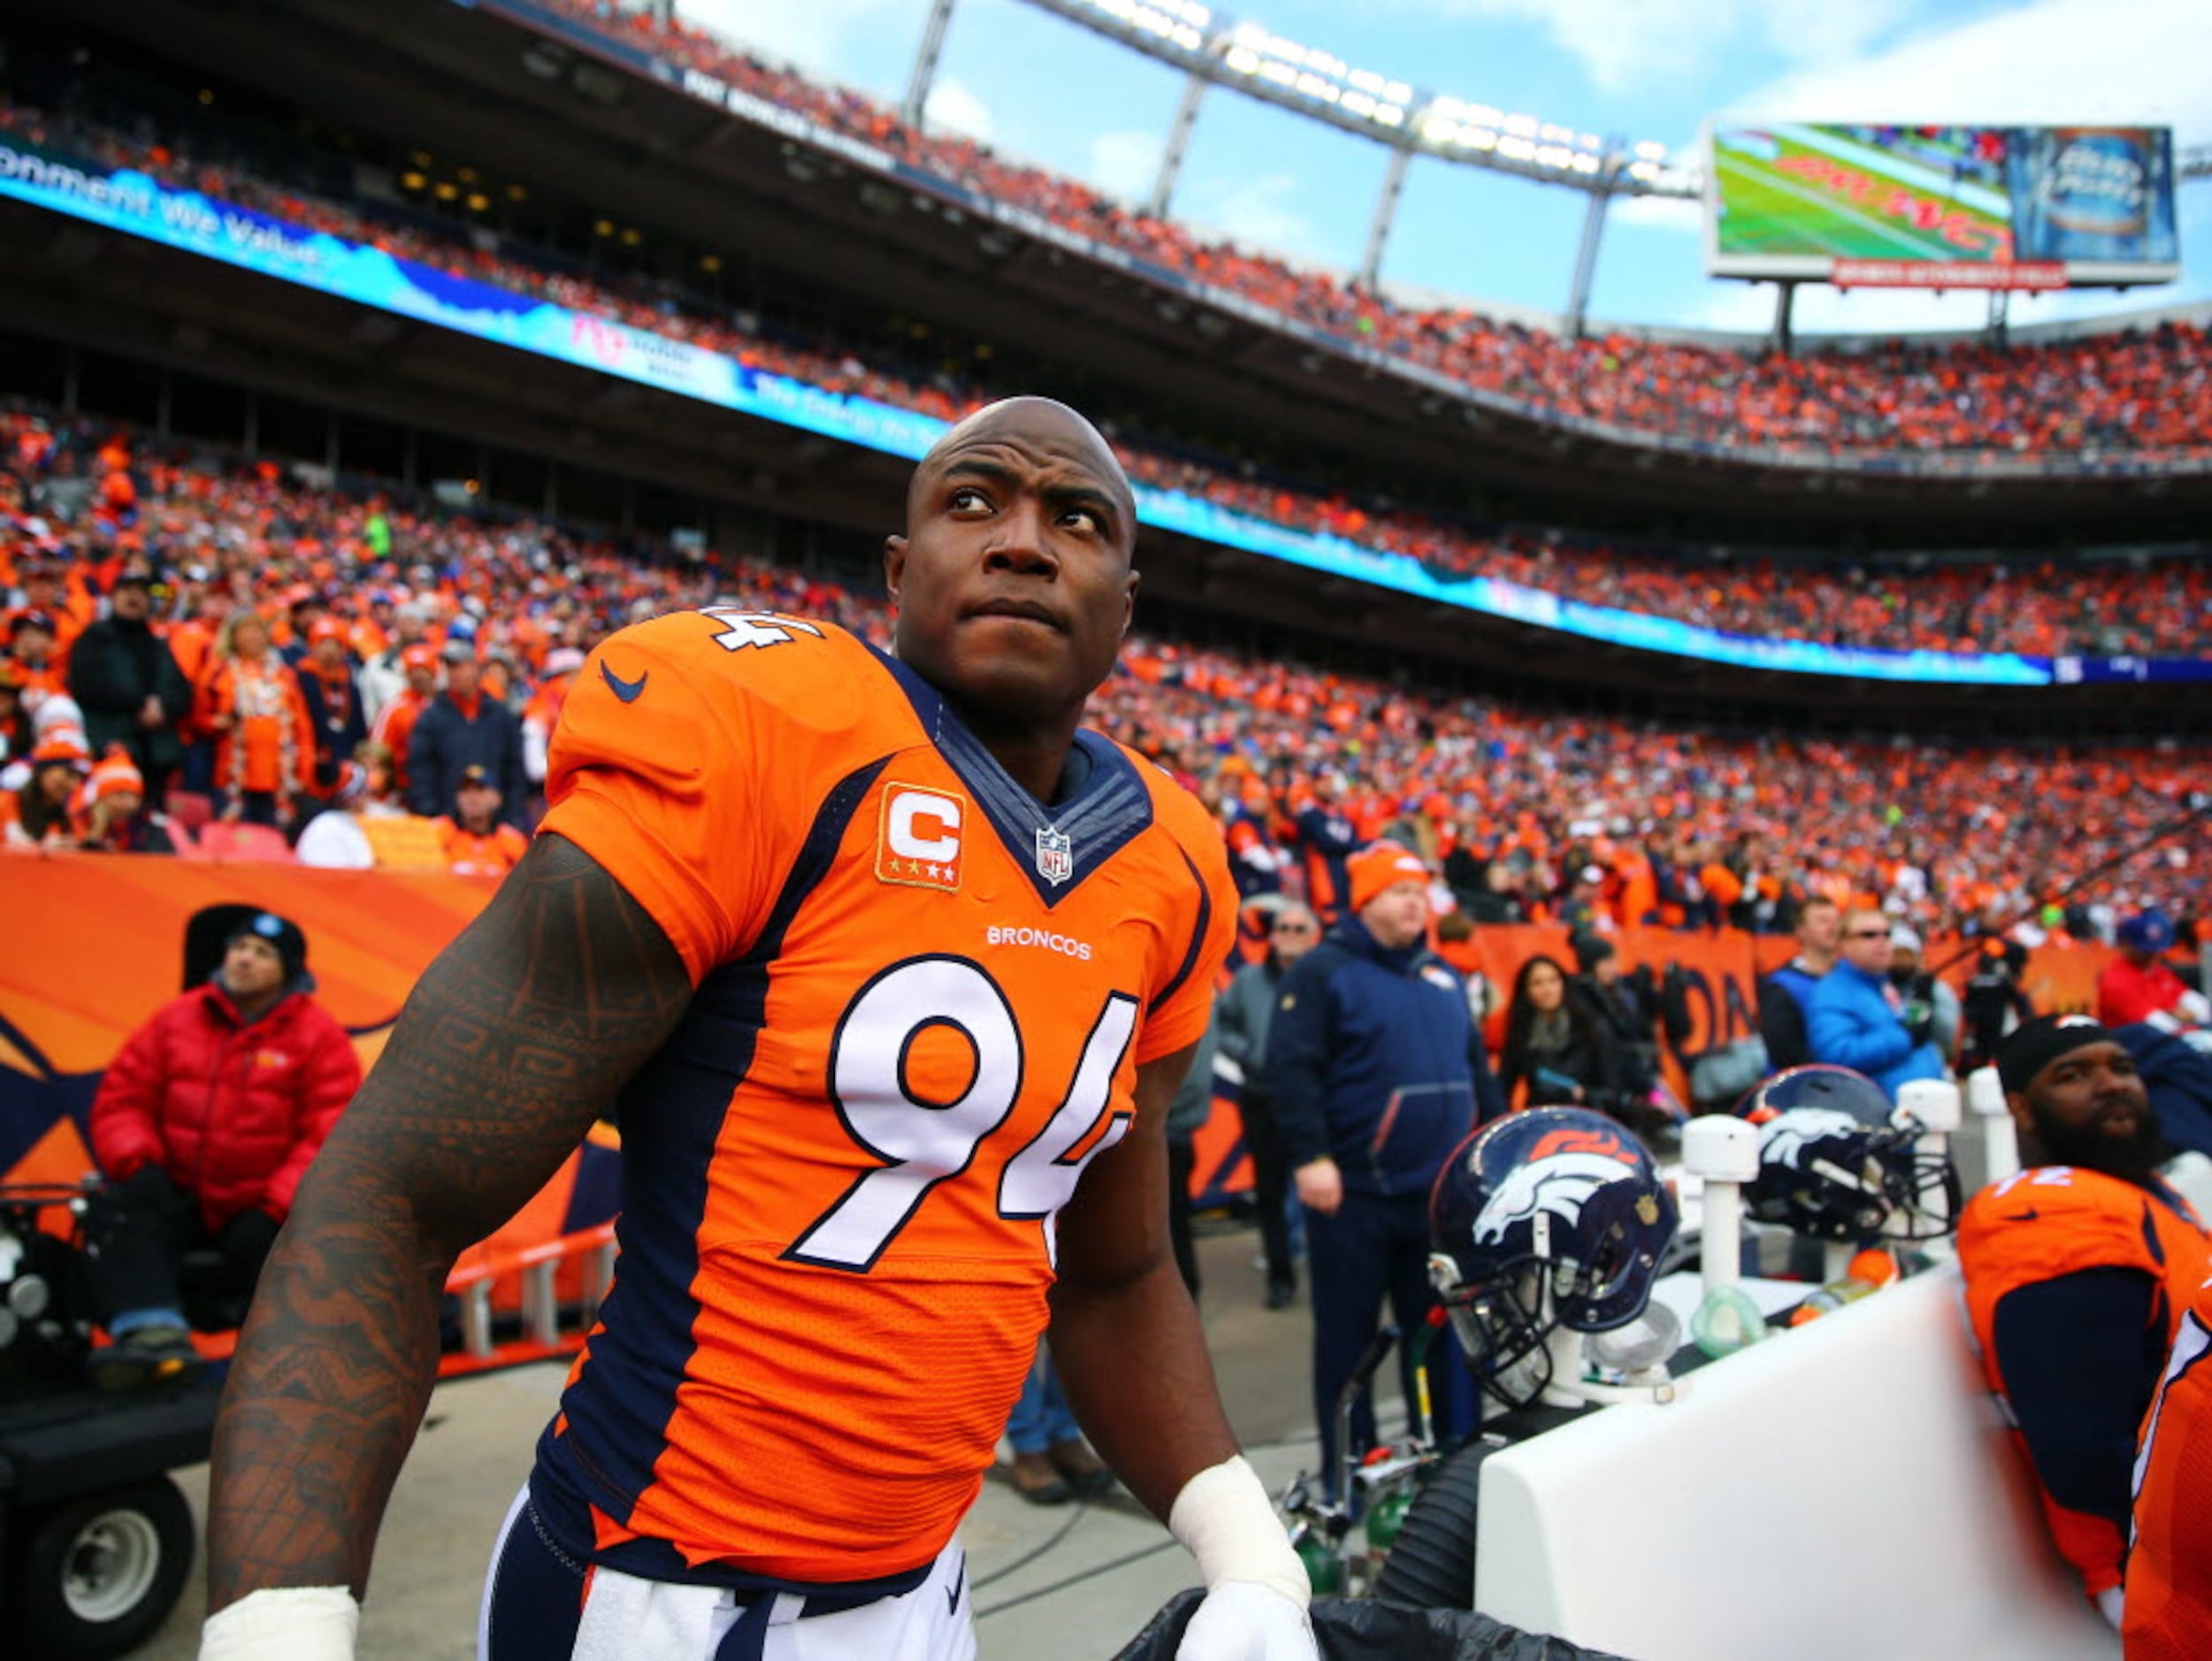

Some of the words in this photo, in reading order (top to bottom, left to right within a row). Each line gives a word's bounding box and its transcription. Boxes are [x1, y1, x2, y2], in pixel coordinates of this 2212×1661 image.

[888, 791, 961, 864] C
[1042, 849, 1070, 874] NFL
[986, 925, 1092, 961] BRONCOS
